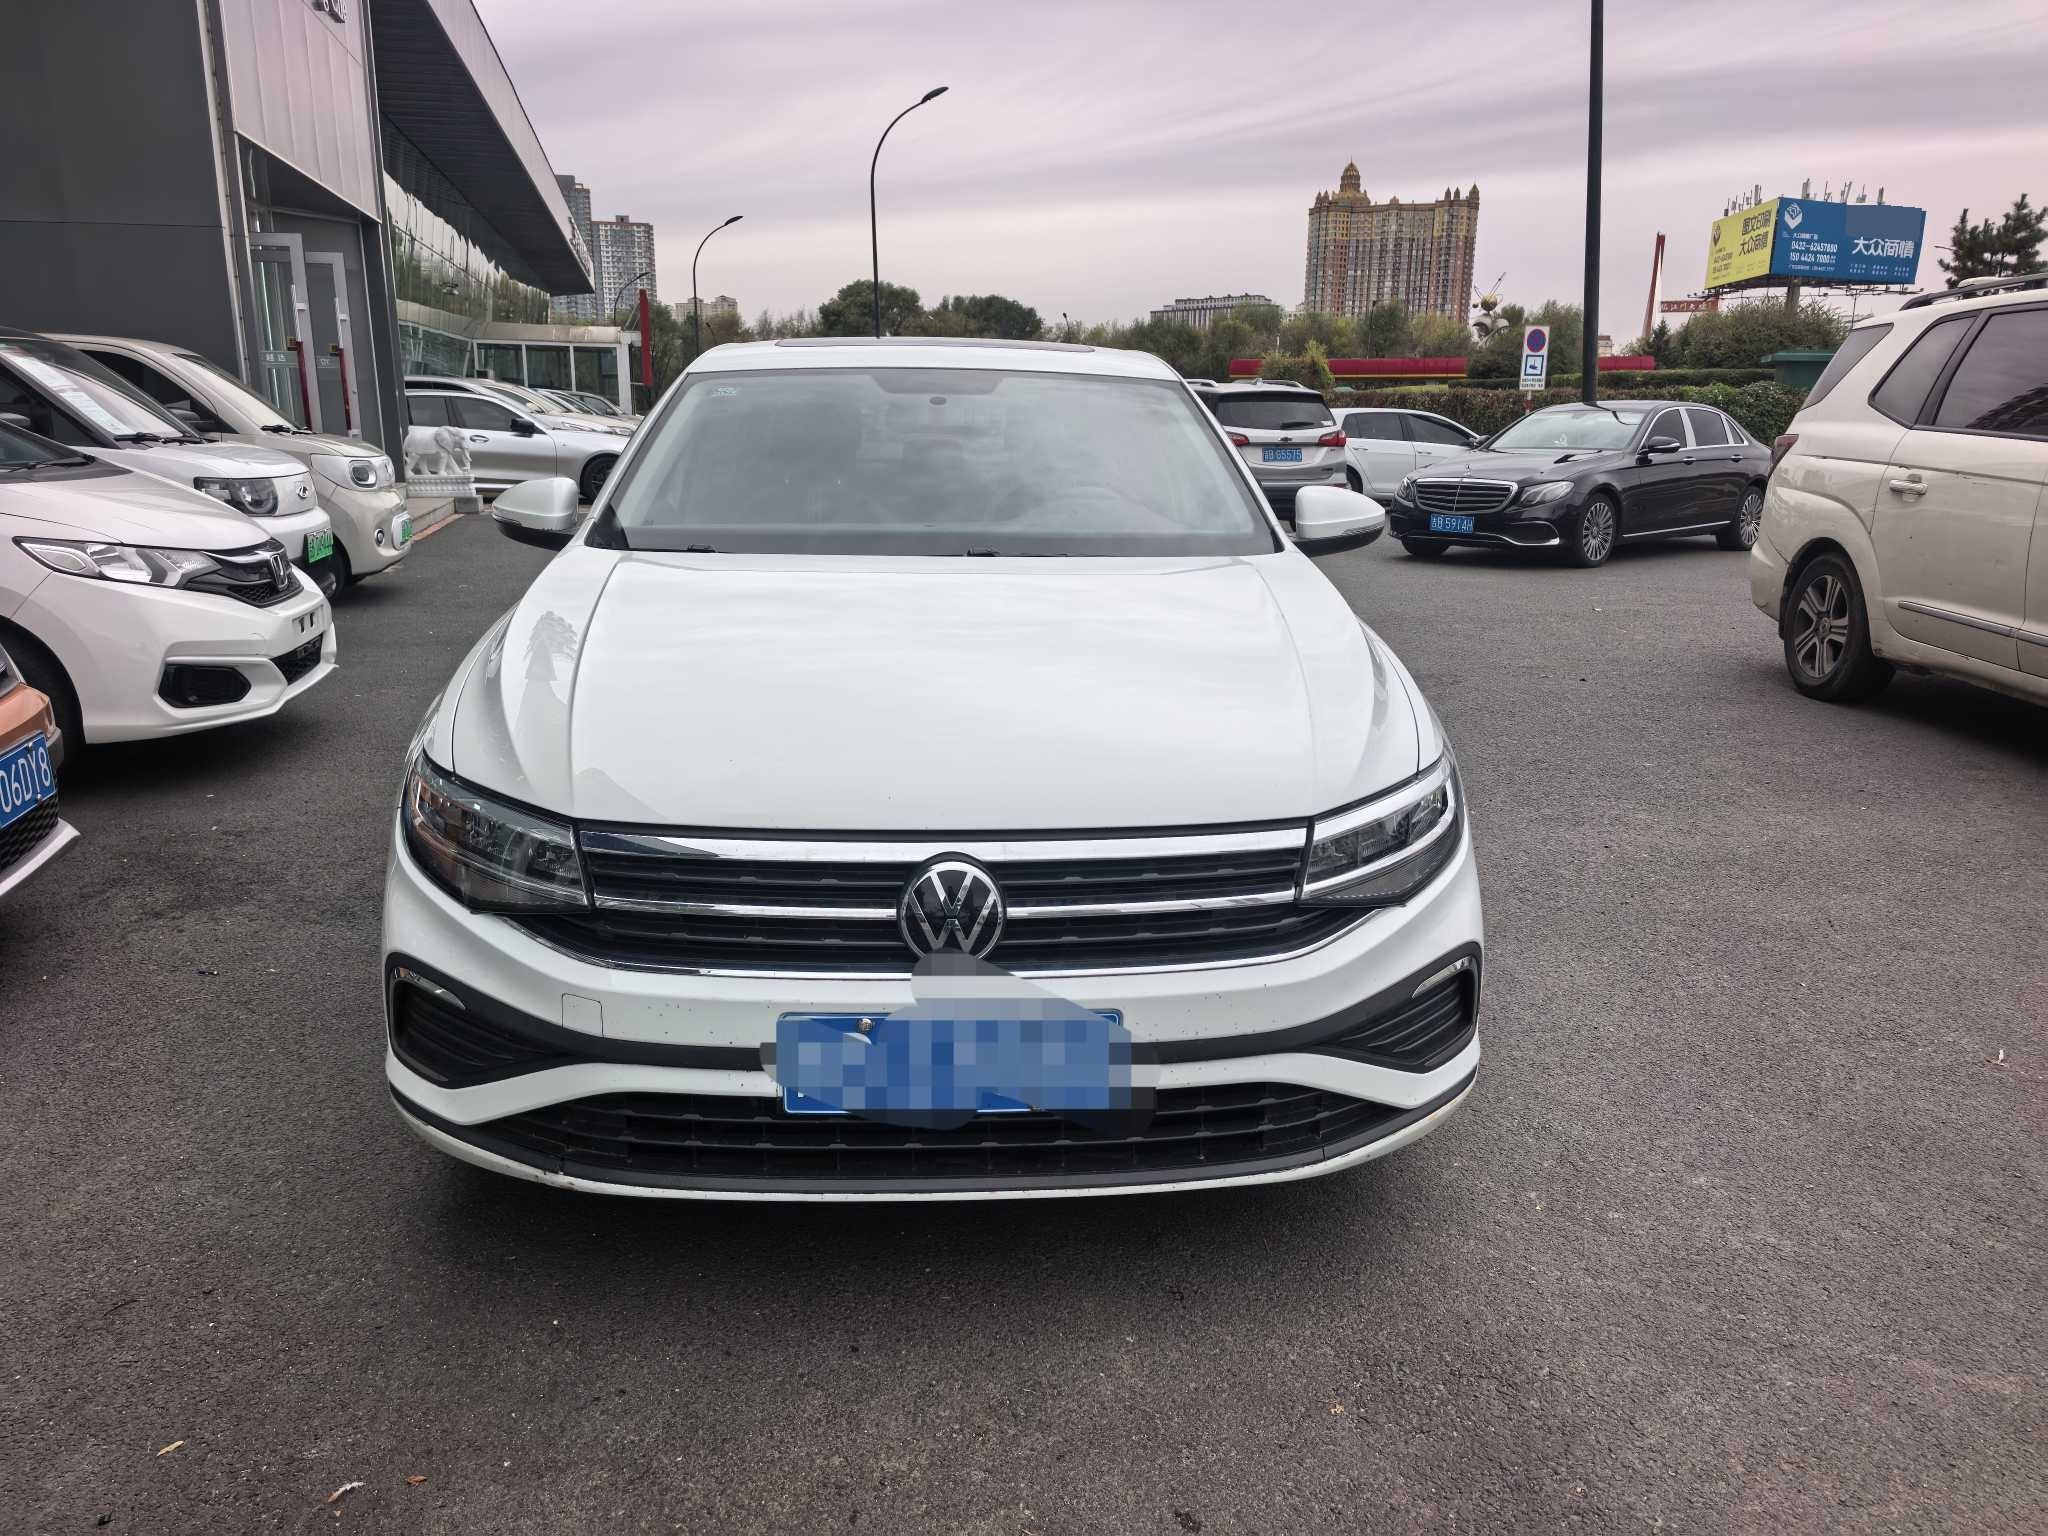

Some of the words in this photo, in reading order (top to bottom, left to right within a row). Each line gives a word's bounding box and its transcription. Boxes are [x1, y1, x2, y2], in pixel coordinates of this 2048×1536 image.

[1739, 231, 1768, 256] 大众商情
[1852, 237, 1914, 258] 大众商情
